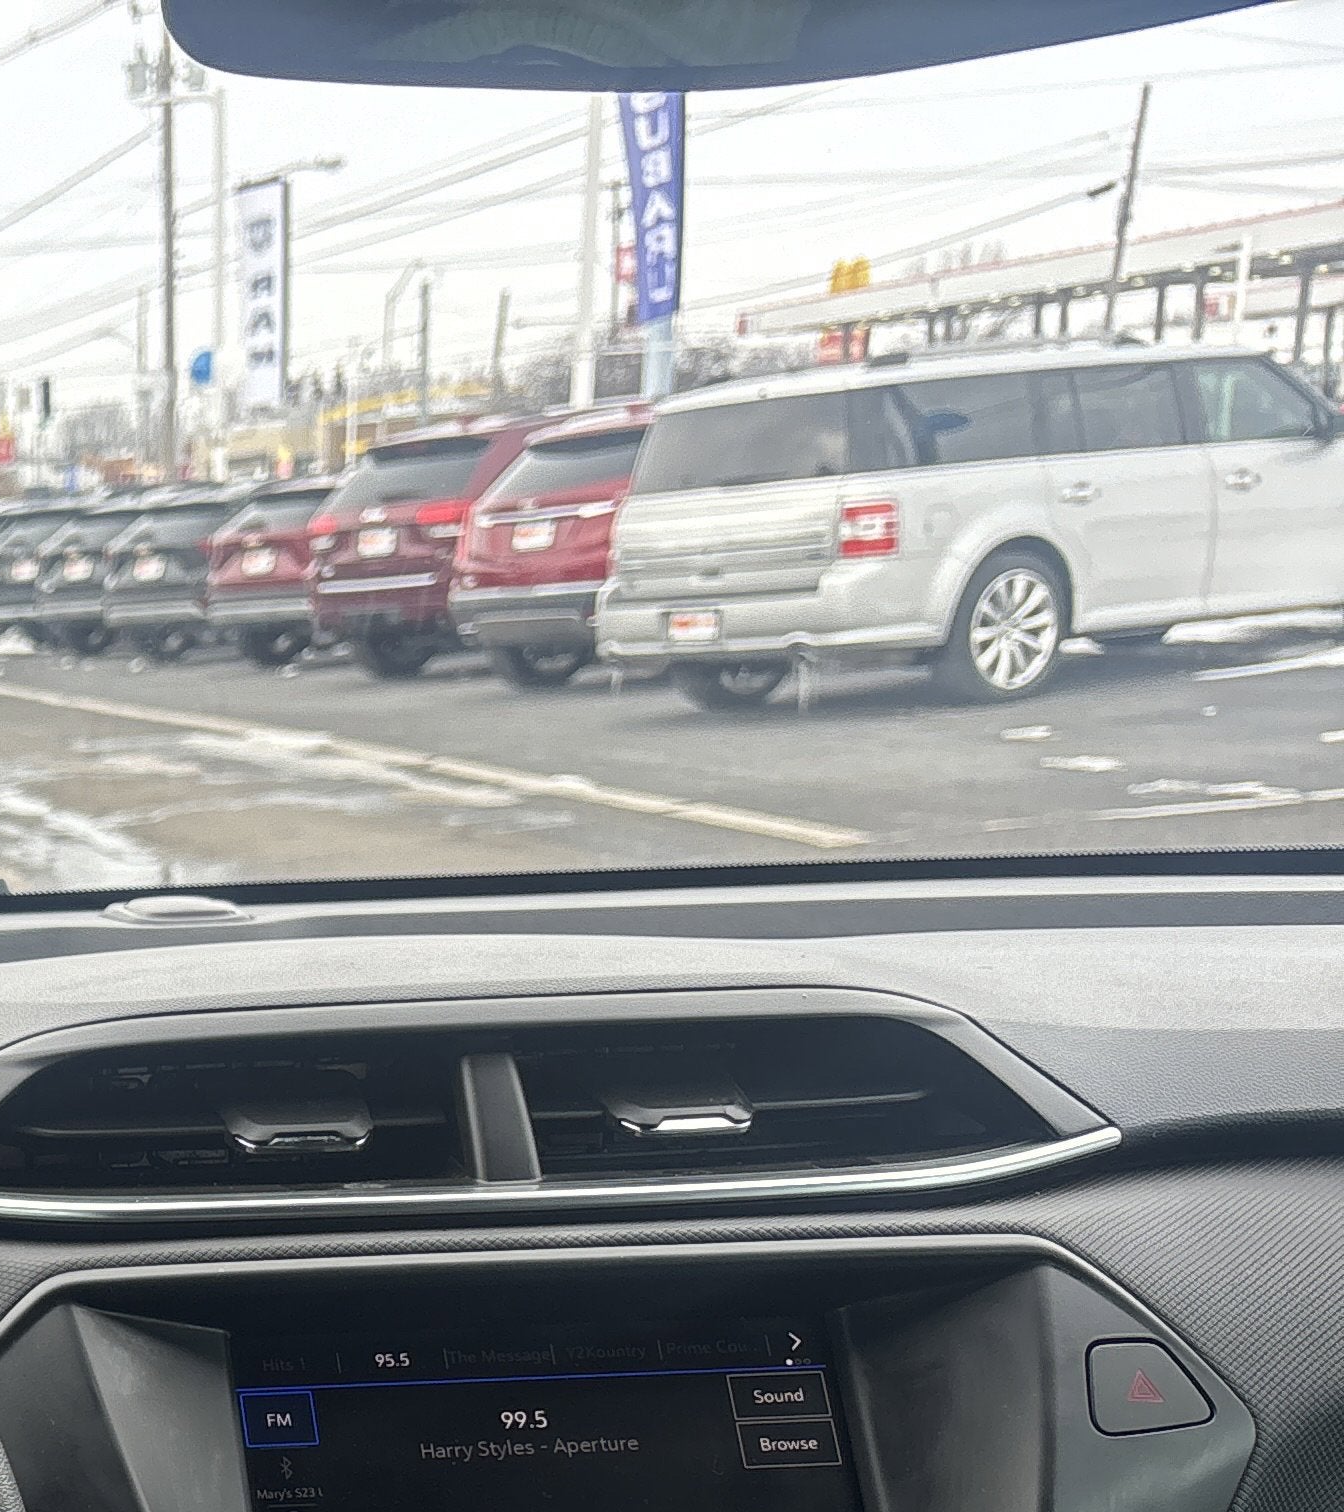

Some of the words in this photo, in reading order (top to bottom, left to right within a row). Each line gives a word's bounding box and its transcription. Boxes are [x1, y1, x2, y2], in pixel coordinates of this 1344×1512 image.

[373, 1353, 410, 1368] 95.5
[448, 1350, 477, 1364] The
[753, 1387, 804, 1404] Sound
[266, 1412, 292, 1427] FM
[500, 1410, 548, 1430] 99.5
[420, 1442, 474, 1462] Harry
[477, 1438, 536, 1461] Styles
[553, 1437, 640, 1458] Aperture
[759, 1437, 819, 1452] Browse
[256, 1487, 293, 1501] Mary's
[295, 1487, 316, 1498] S23
